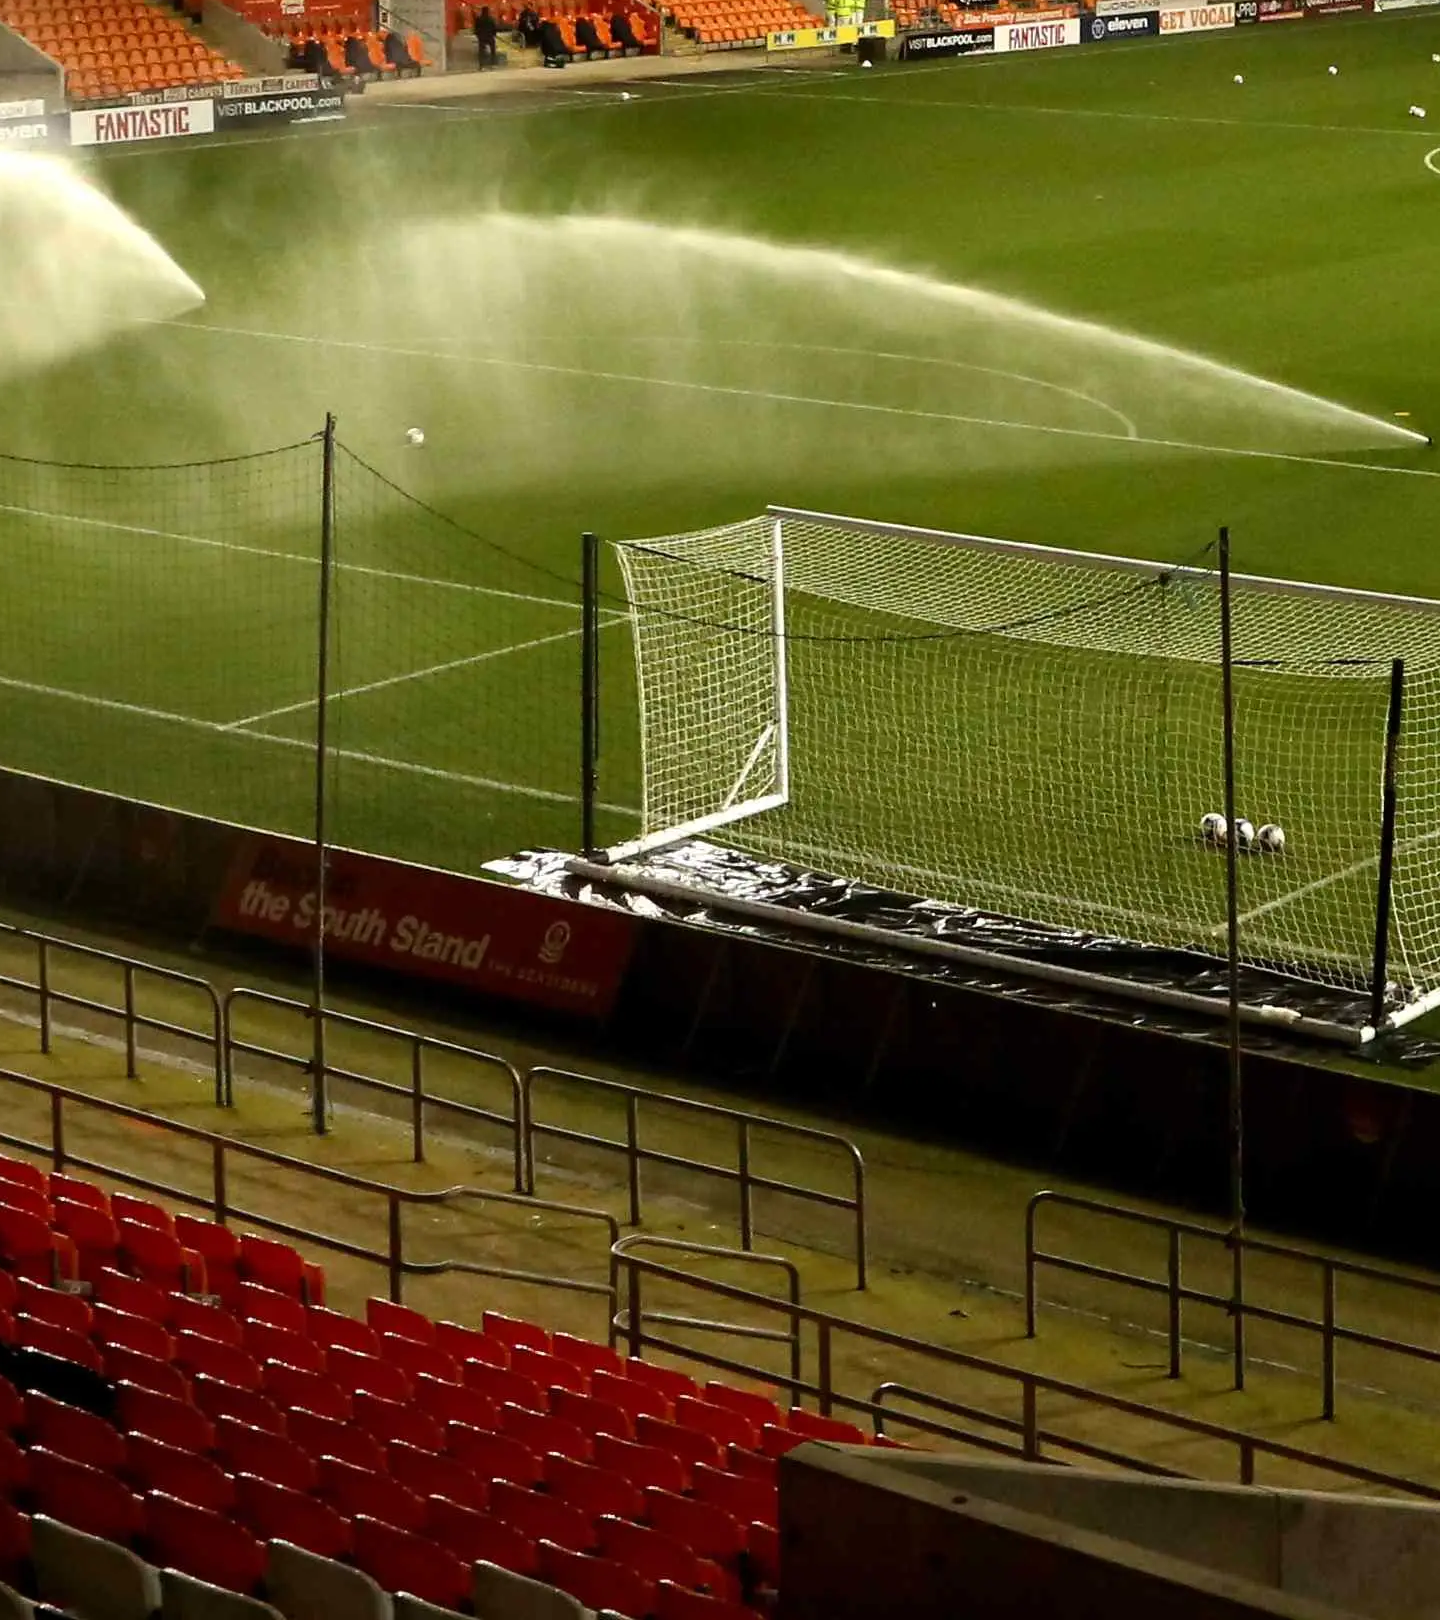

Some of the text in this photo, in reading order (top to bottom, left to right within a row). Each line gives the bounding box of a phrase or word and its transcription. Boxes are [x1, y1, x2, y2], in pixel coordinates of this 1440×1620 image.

[1107, 15, 1149, 33] eleven
[1160, 4, 1234, 30] GET VOCAL
[1009, 23, 1065, 50] FANTASTIC
[217, 96, 342, 118] VISITBLACKPOOL.com
[95, 106, 190, 141] FANTASTIC
[239, 882, 492, 970] the South Stand
